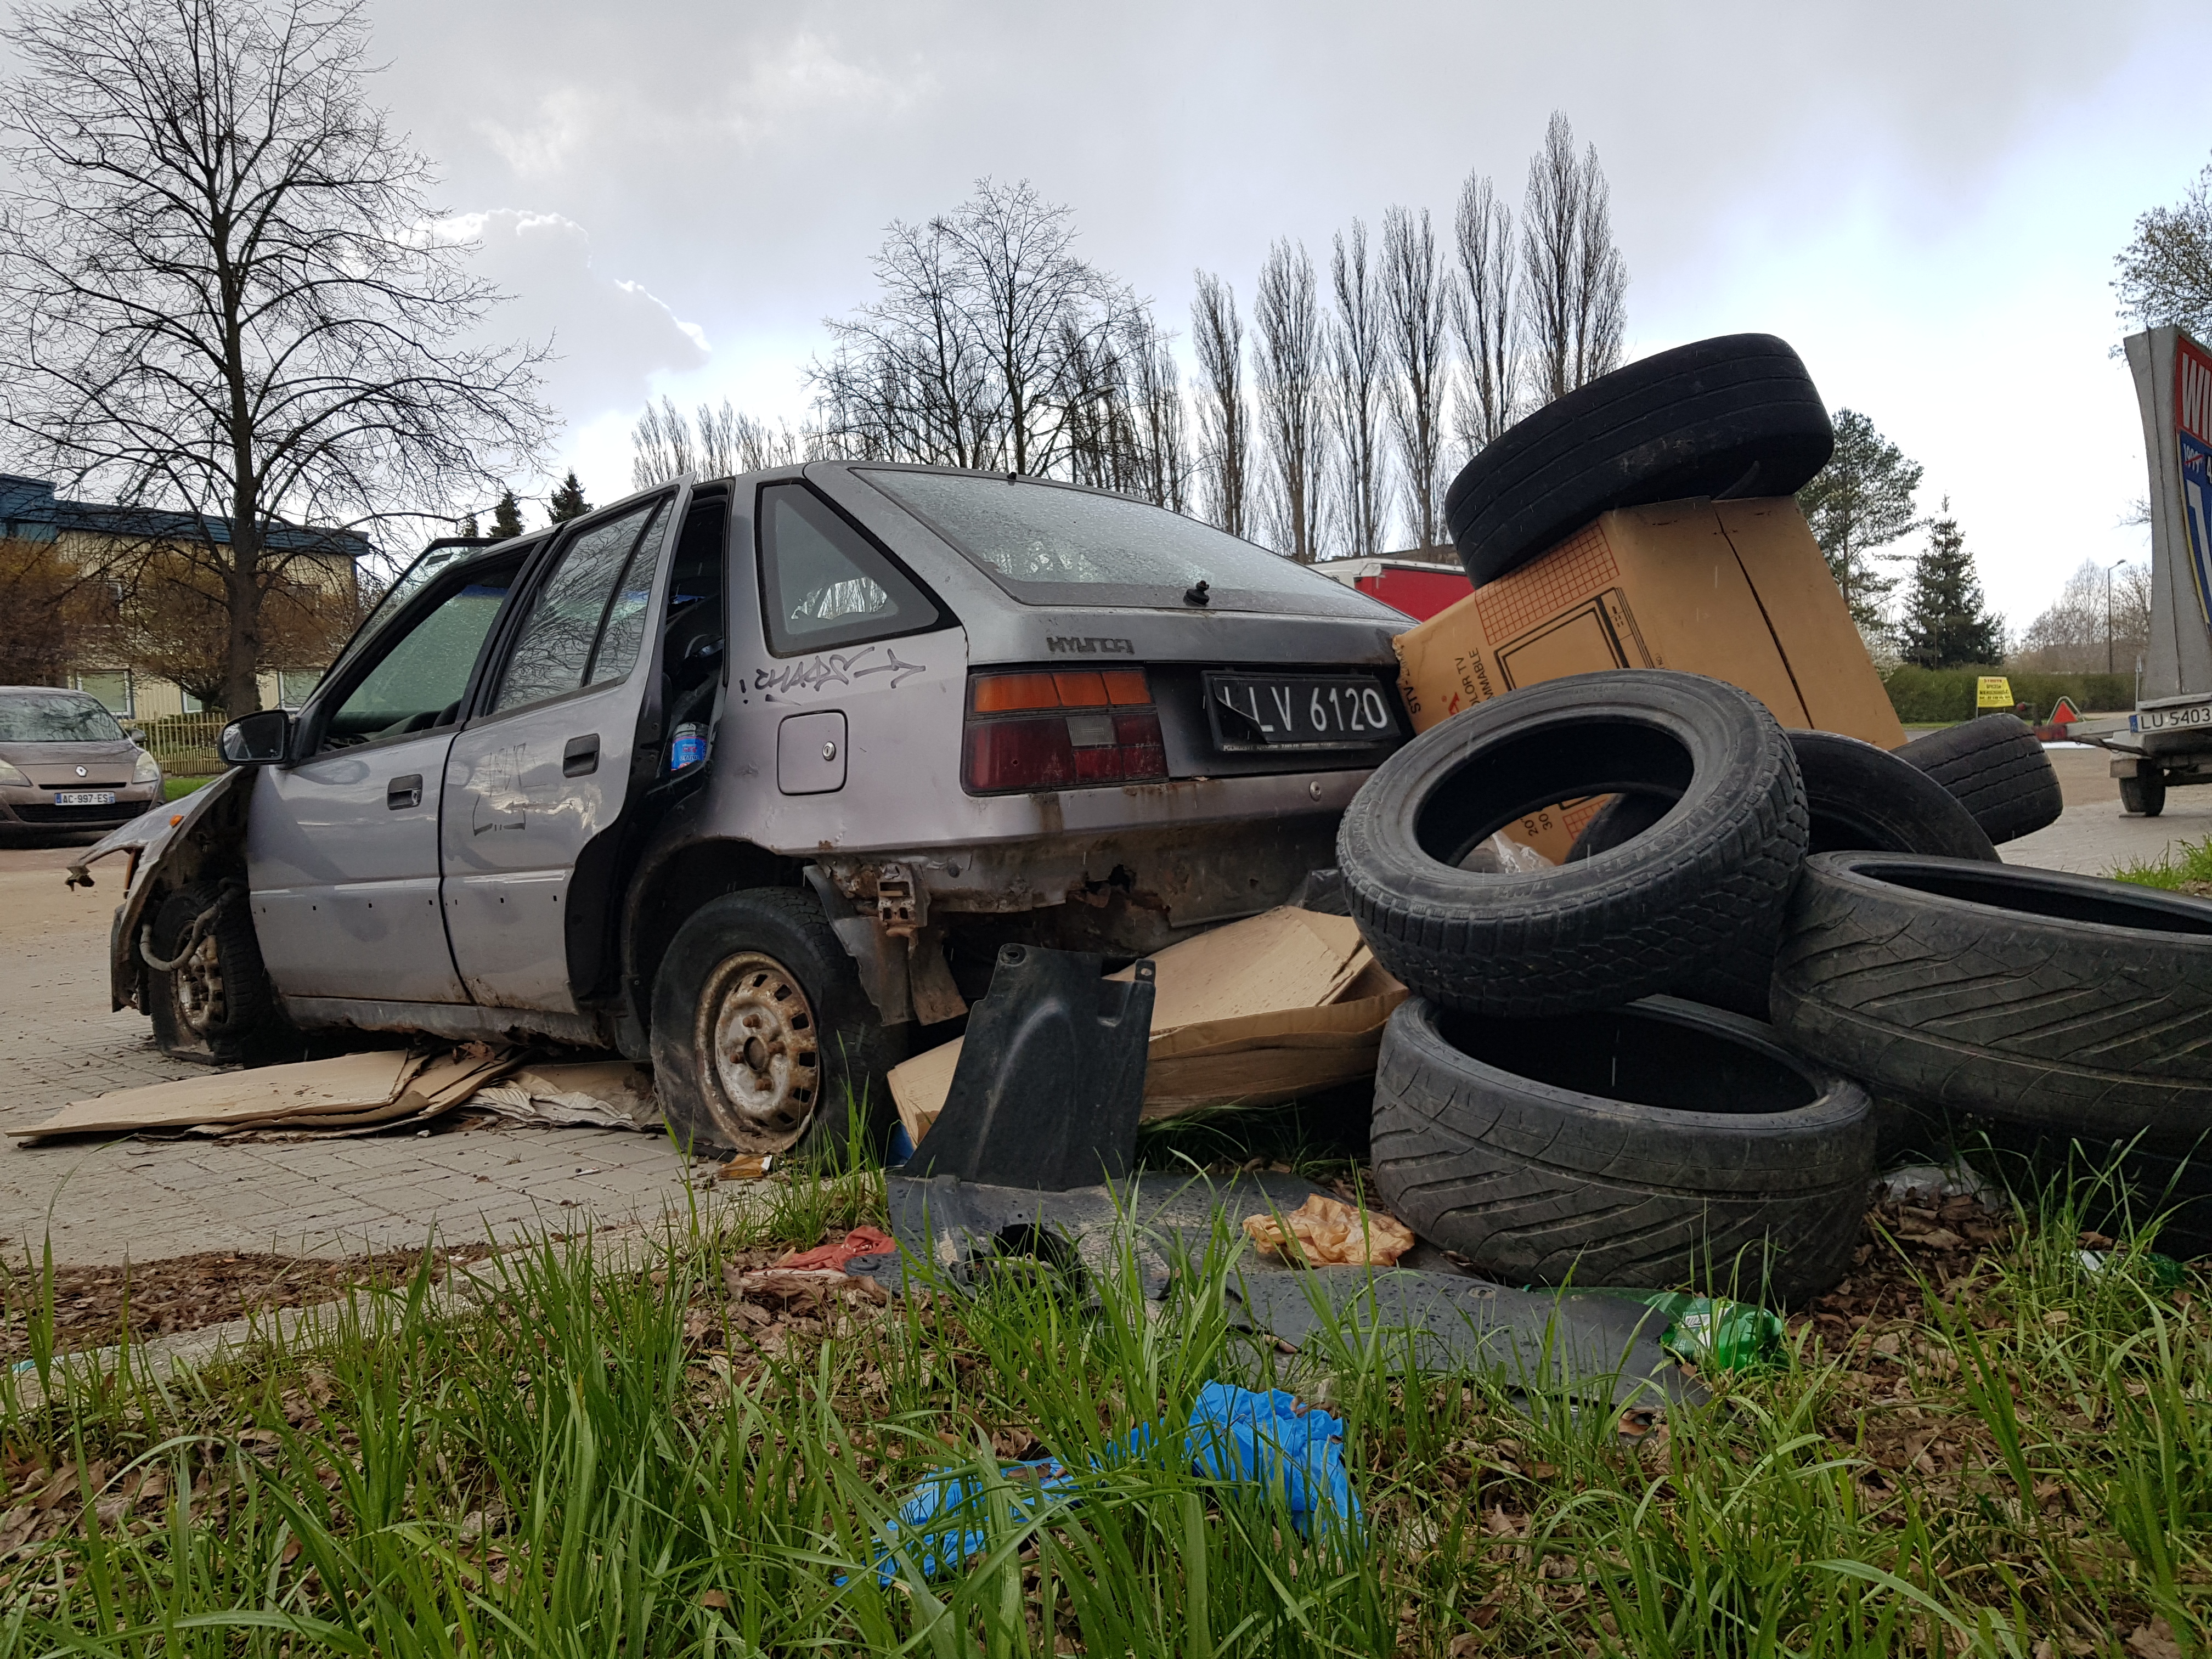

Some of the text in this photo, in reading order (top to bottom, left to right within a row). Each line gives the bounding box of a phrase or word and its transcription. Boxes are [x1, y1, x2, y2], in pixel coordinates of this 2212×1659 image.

[1454, 657, 1464, 675] TV
[1310, 687, 1388, 732] 6120
[2141, 713, 2163, 729] LU
[1468, 647, 1553, 831] 30 MMABLE
